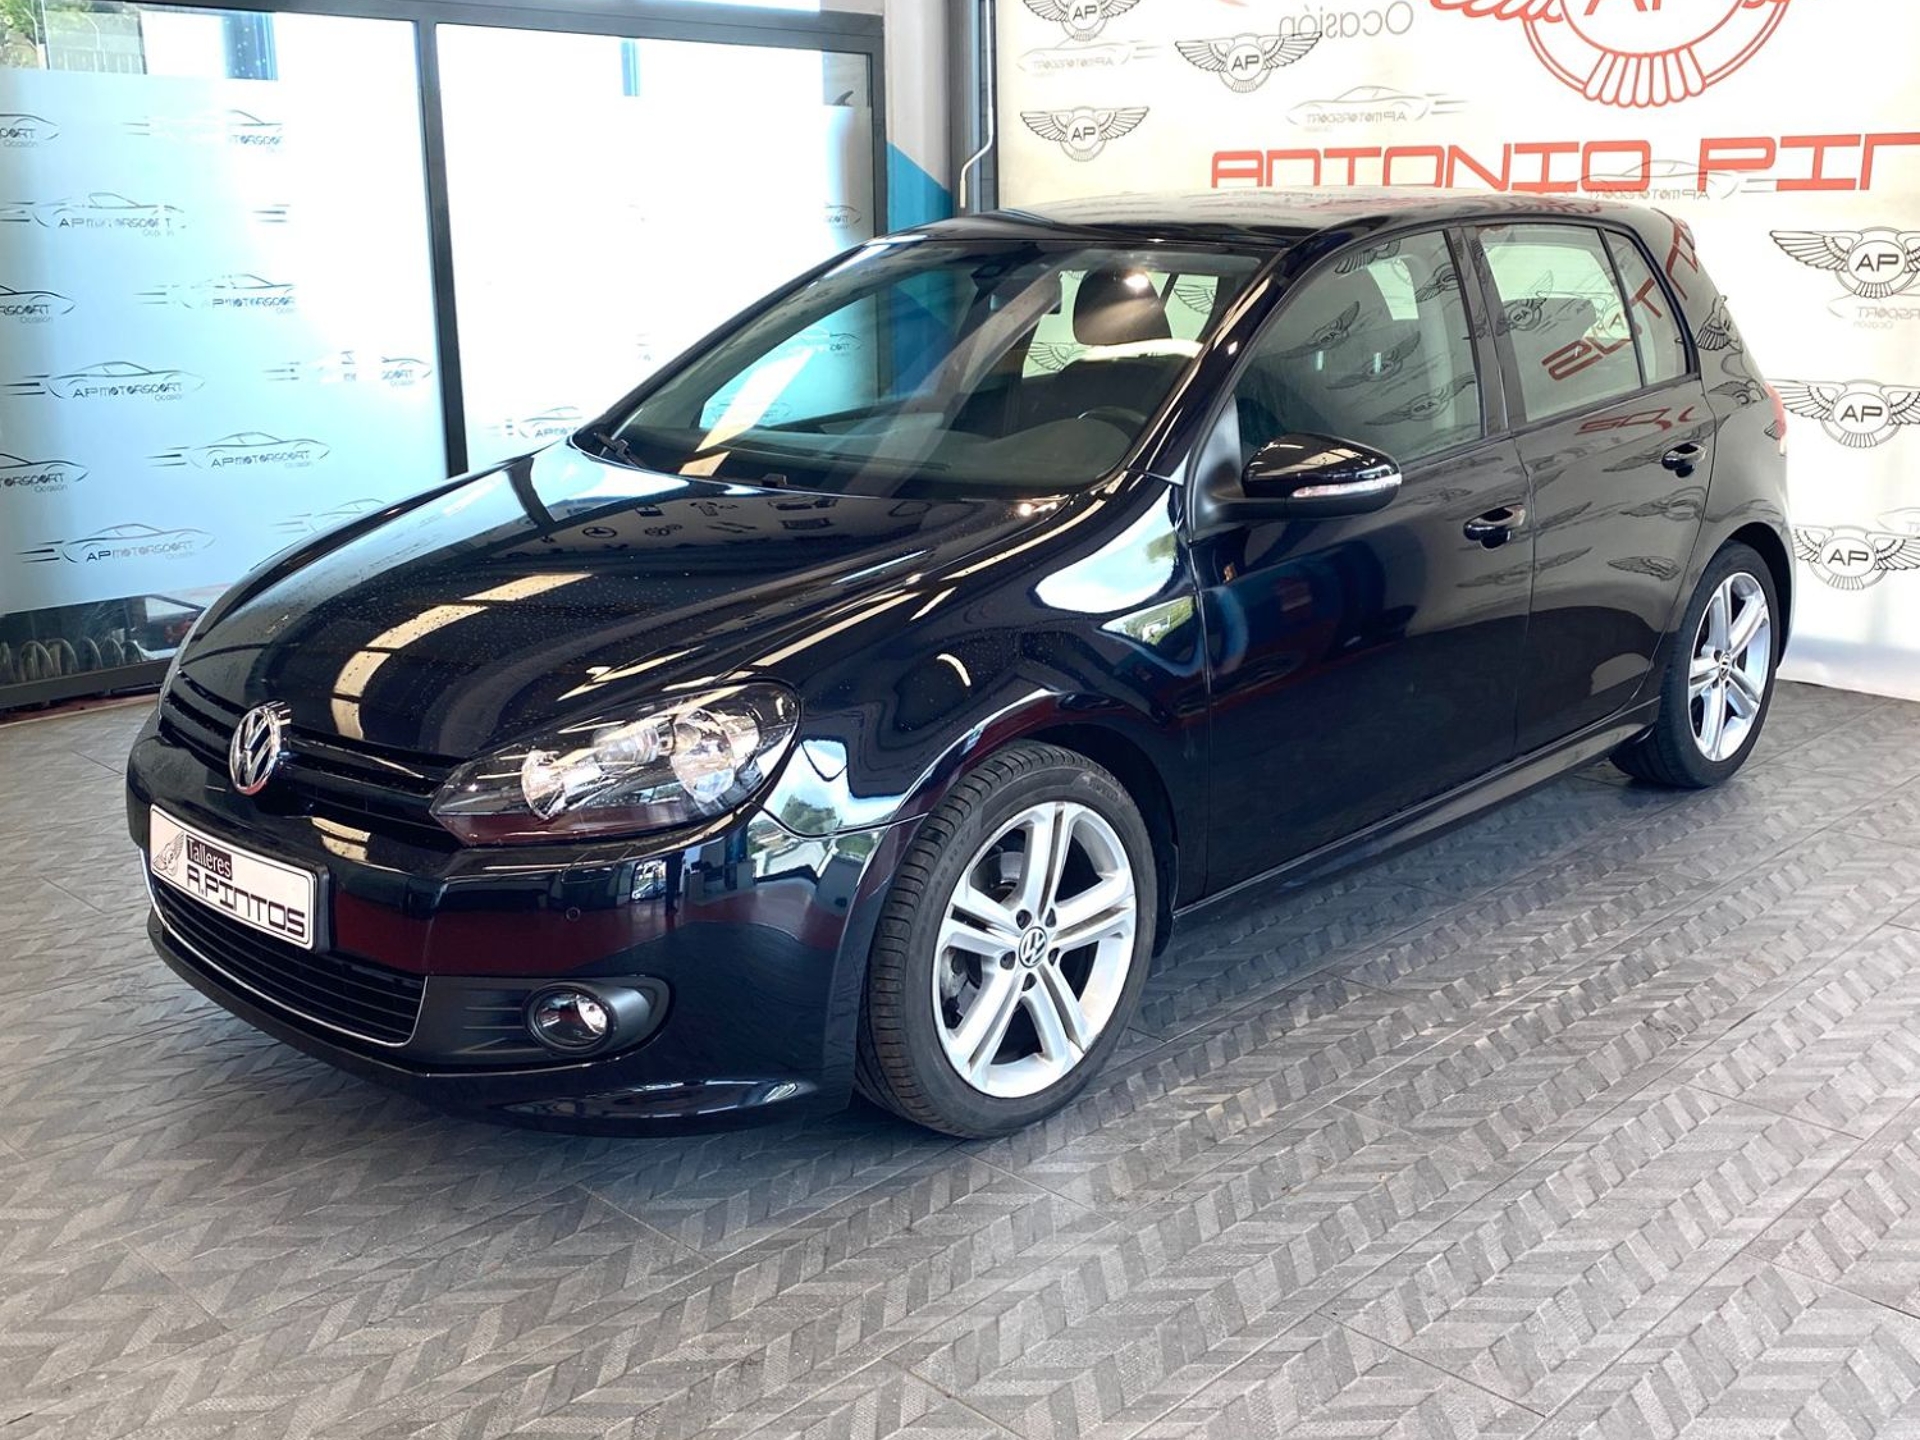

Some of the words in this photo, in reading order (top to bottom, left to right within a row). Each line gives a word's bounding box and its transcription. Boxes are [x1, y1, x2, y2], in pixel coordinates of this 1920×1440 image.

[1072, 4, 1098, 21] AP
[1231, 54, 1260, 72] AP
[1070, 126, 1097, 142] AP
[1855, 253, 1899, 272] AP
[1840, 405, 1883, 422] AP
[1827, 548, 1869, 566] AP
[188, 837, 232, 878] Talleres
